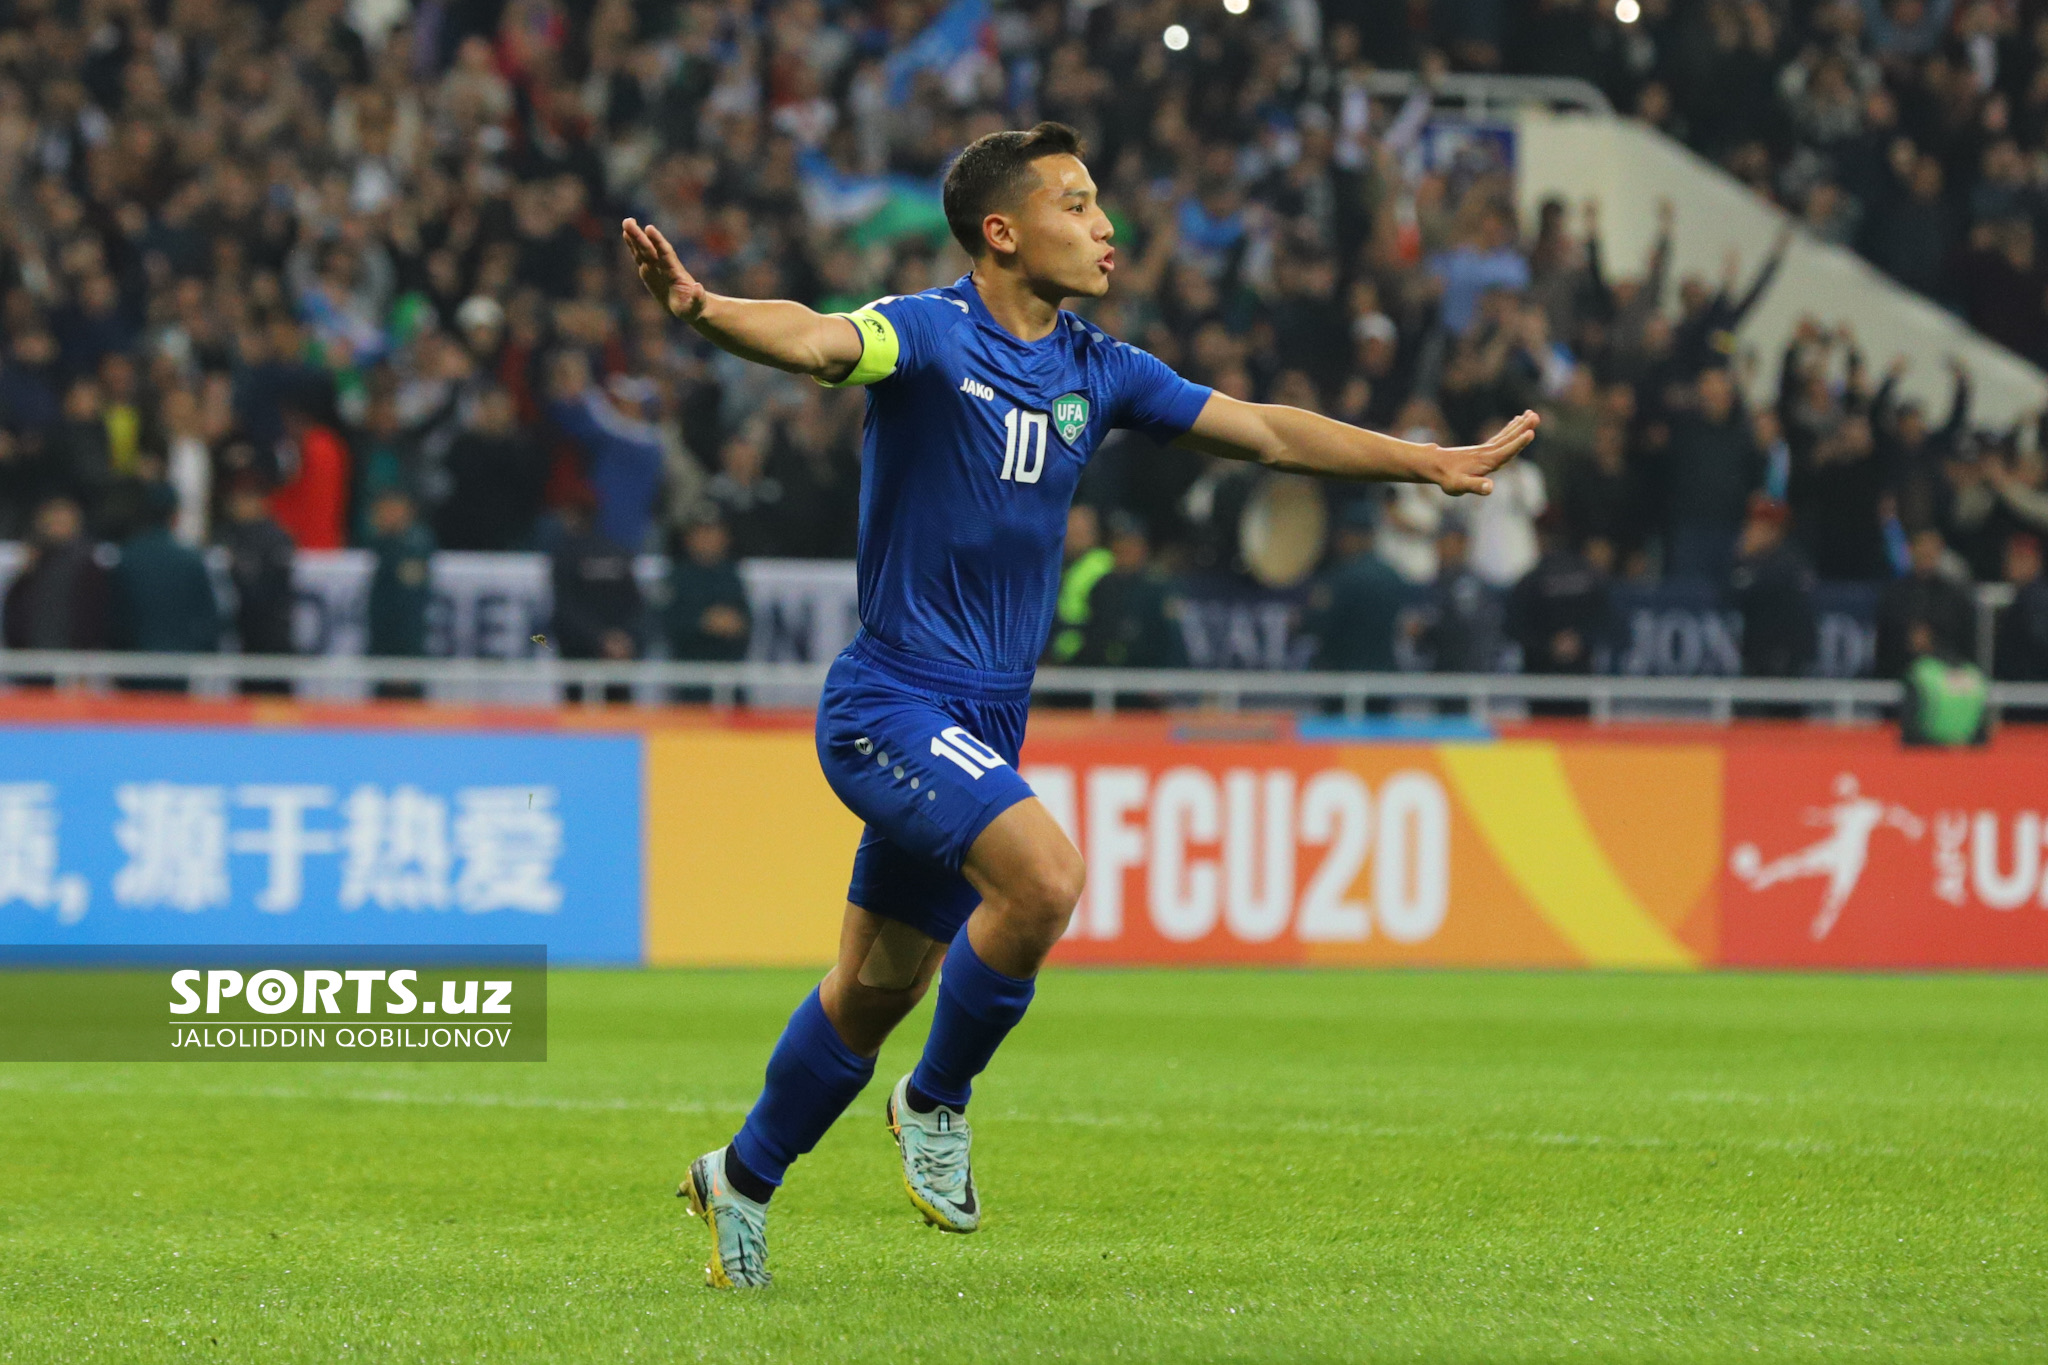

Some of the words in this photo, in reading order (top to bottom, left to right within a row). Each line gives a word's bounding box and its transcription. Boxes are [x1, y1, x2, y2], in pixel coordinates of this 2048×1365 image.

[960, 377, 995, 402] JAKO
[1057, 403, 1084, 422] UFA
[1000, 407, 1049, 484] 10
[930, 726, 1007, 780] 10
[1972, 809, 2048, 911] U
